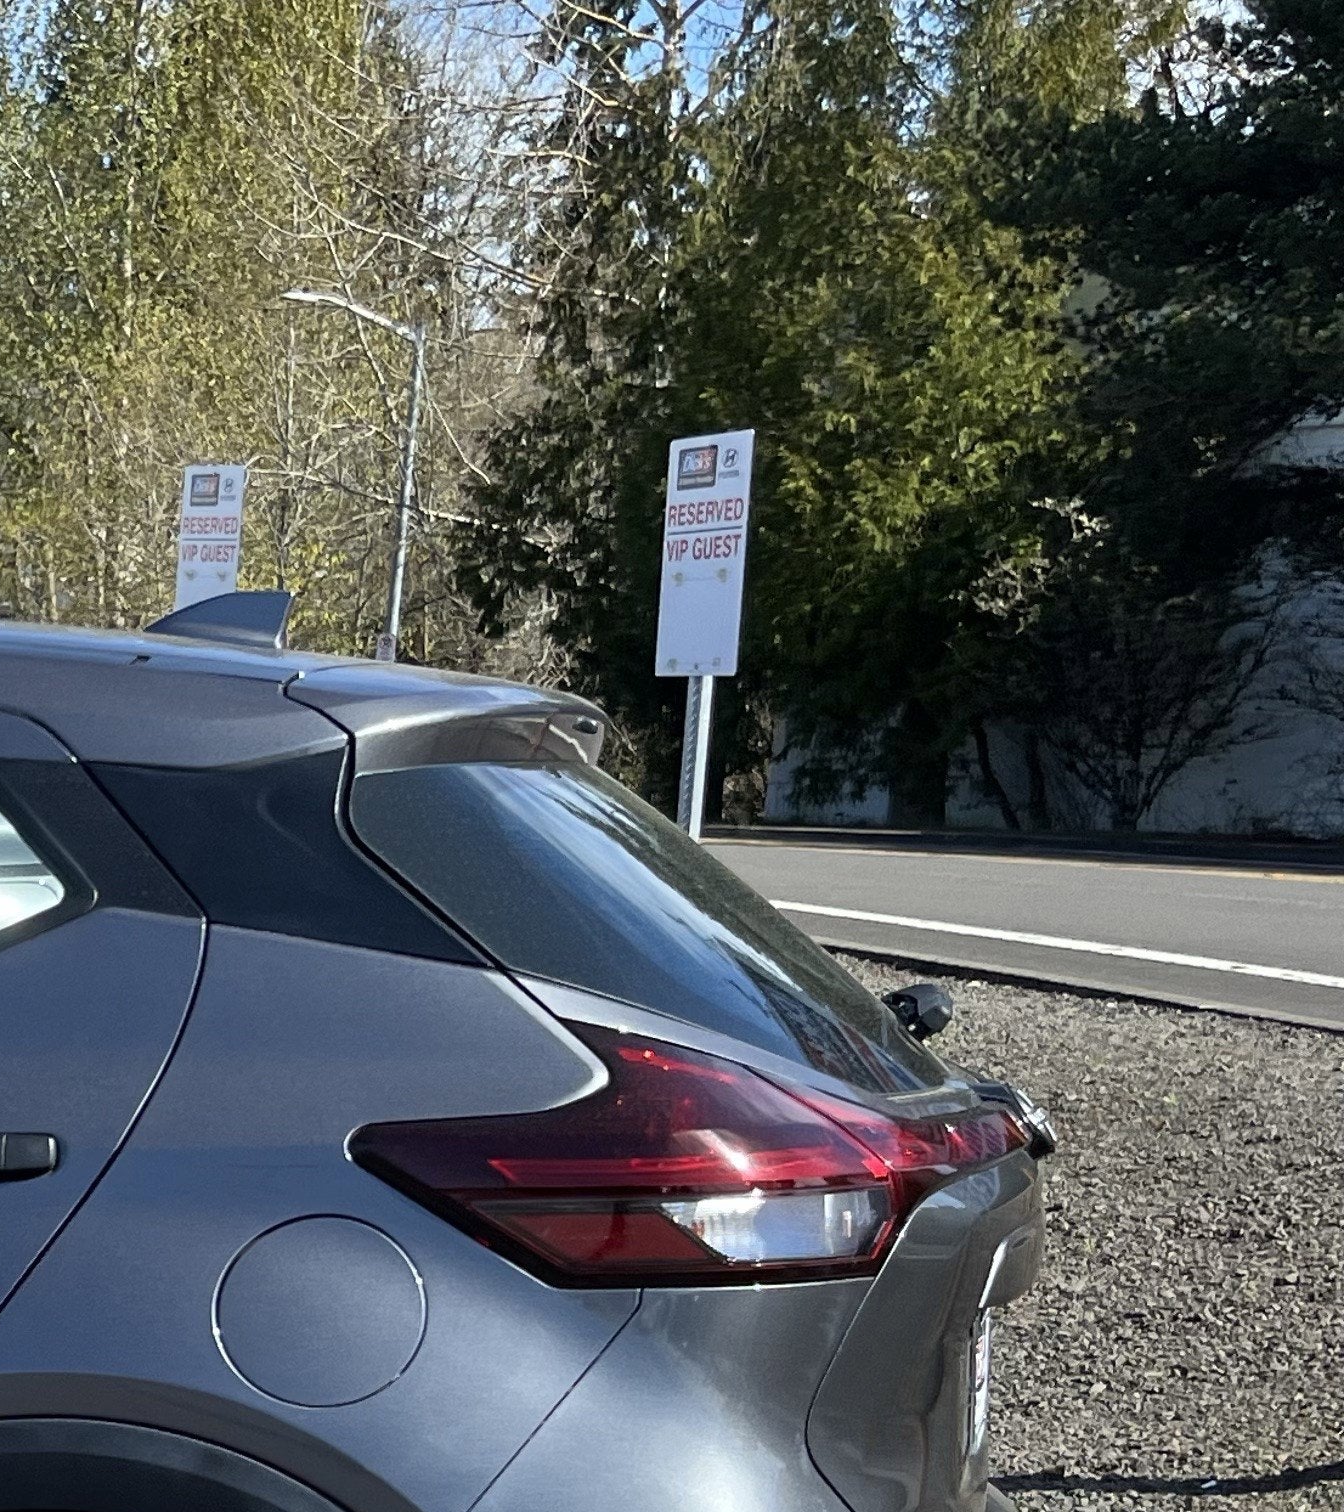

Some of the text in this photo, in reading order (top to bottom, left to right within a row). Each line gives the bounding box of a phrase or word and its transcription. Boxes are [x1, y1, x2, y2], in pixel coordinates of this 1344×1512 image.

[667, 498, 744, 527] RESERVED
[182, 516, 238, 535] RESERVED
[181, 543, 237, 563] VIP GUEST
[666, 533, 742, 561] VIP GUEST
